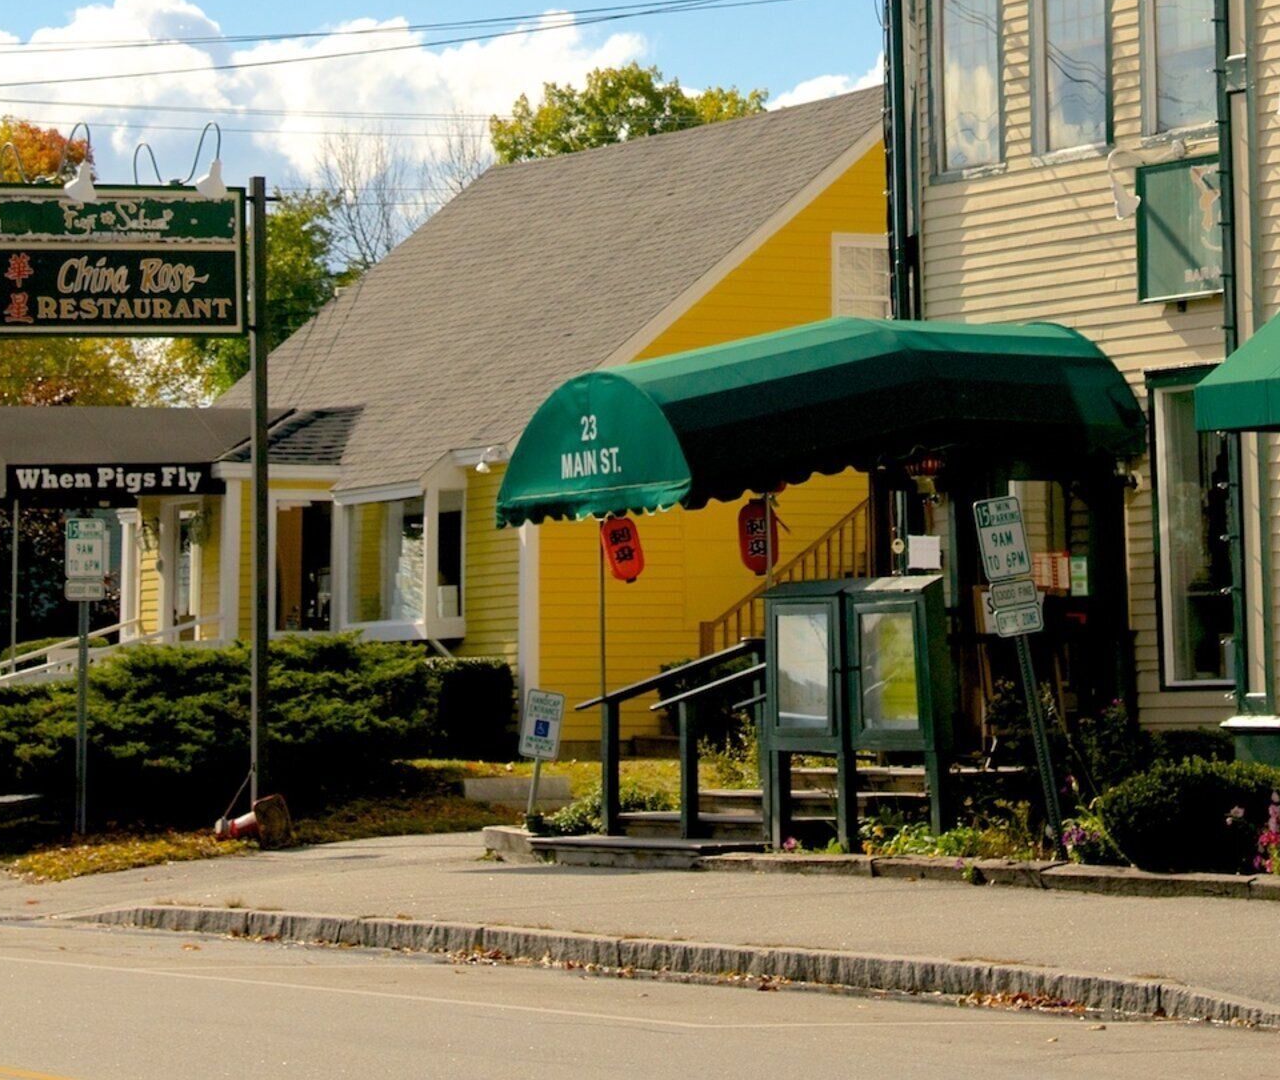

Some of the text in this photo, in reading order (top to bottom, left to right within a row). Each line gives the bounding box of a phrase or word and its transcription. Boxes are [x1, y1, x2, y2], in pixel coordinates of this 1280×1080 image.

[57, 255, 210, 295] China Rose
[36, 296, 233, 321] RESTAURANT
[580, 414, 597, 442] 23
[561, 447, 622, 480] MAIN ST.
[16, 466, 202, 494] When Pigs Fly
[977, 501, 1011, 527] 15 MIN
[990, 511, 1020, 522] PARKING
[68, 521, 78, 538] 15
[991, 530, 1014, 548] 9AM
[76, 544, 94, 555] 9AM
[988, 551, 1026, 571] TO 6PM
